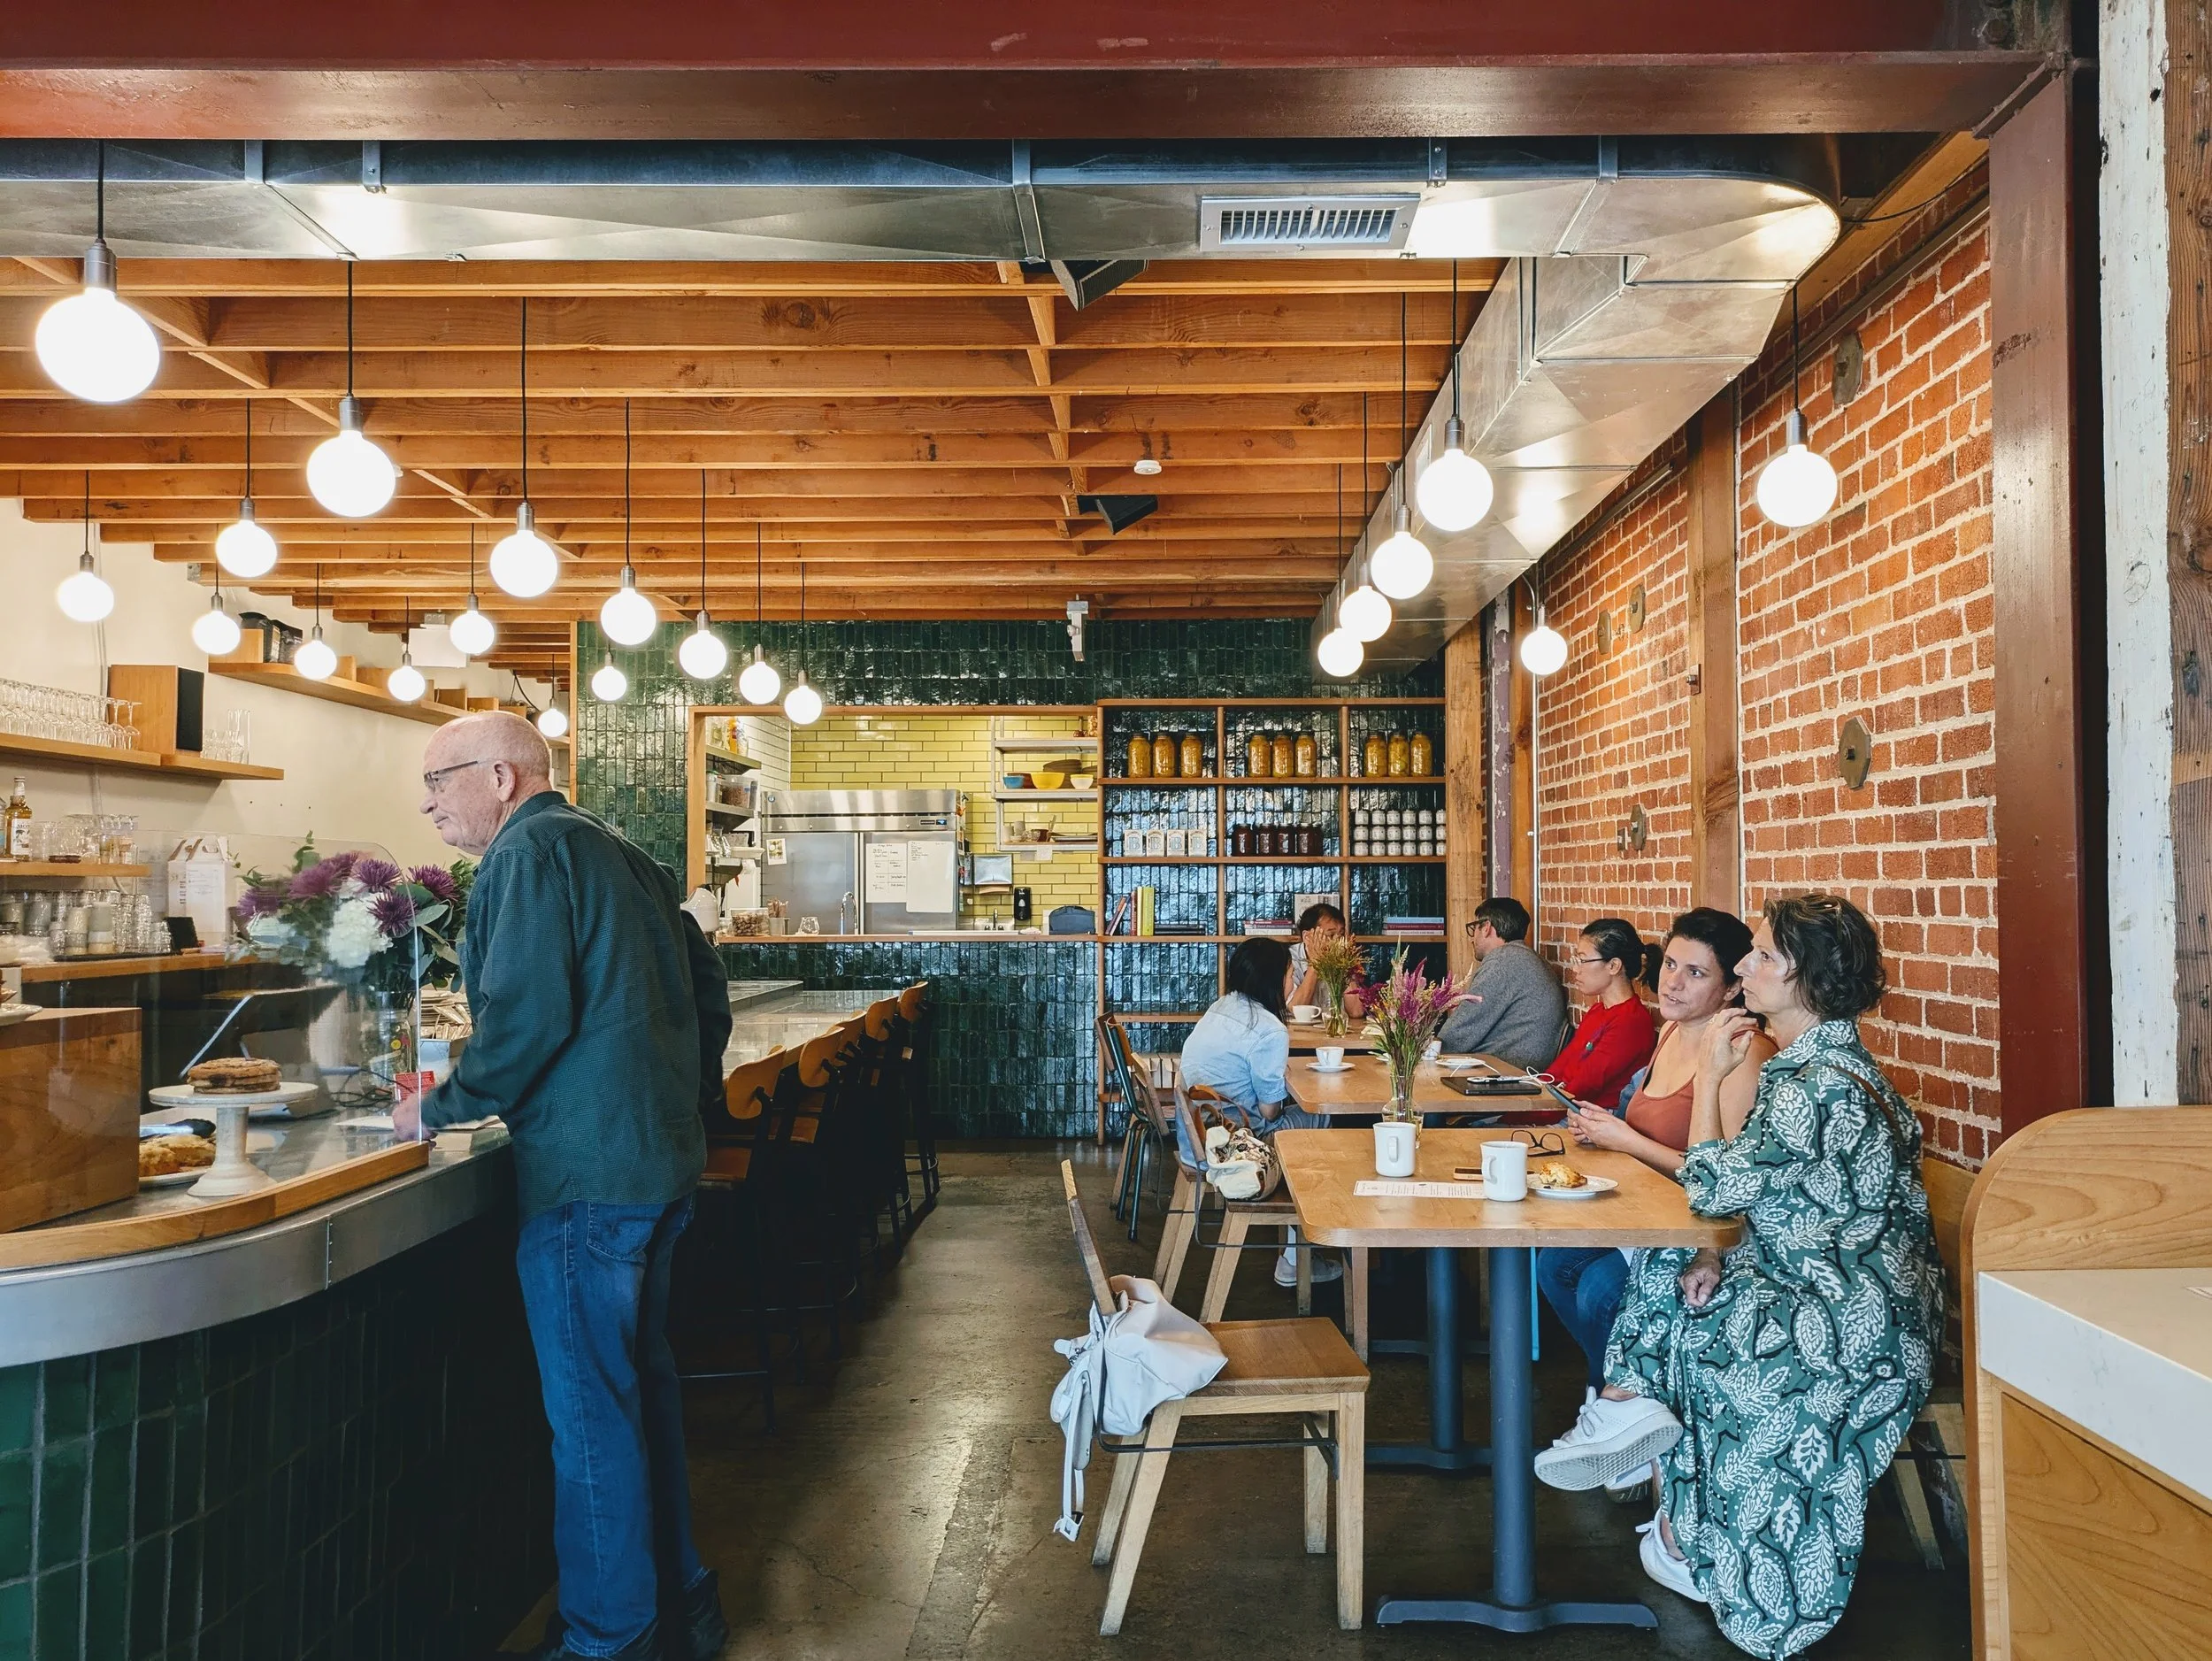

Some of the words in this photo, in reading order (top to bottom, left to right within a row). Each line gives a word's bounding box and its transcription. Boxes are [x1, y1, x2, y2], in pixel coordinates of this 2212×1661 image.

[1128, 836, 1141, 850] B
[1150, 836, 1161, 850] B
[1171, 836, 1182, 850] B
[1193, 836, 1203, 850] B
